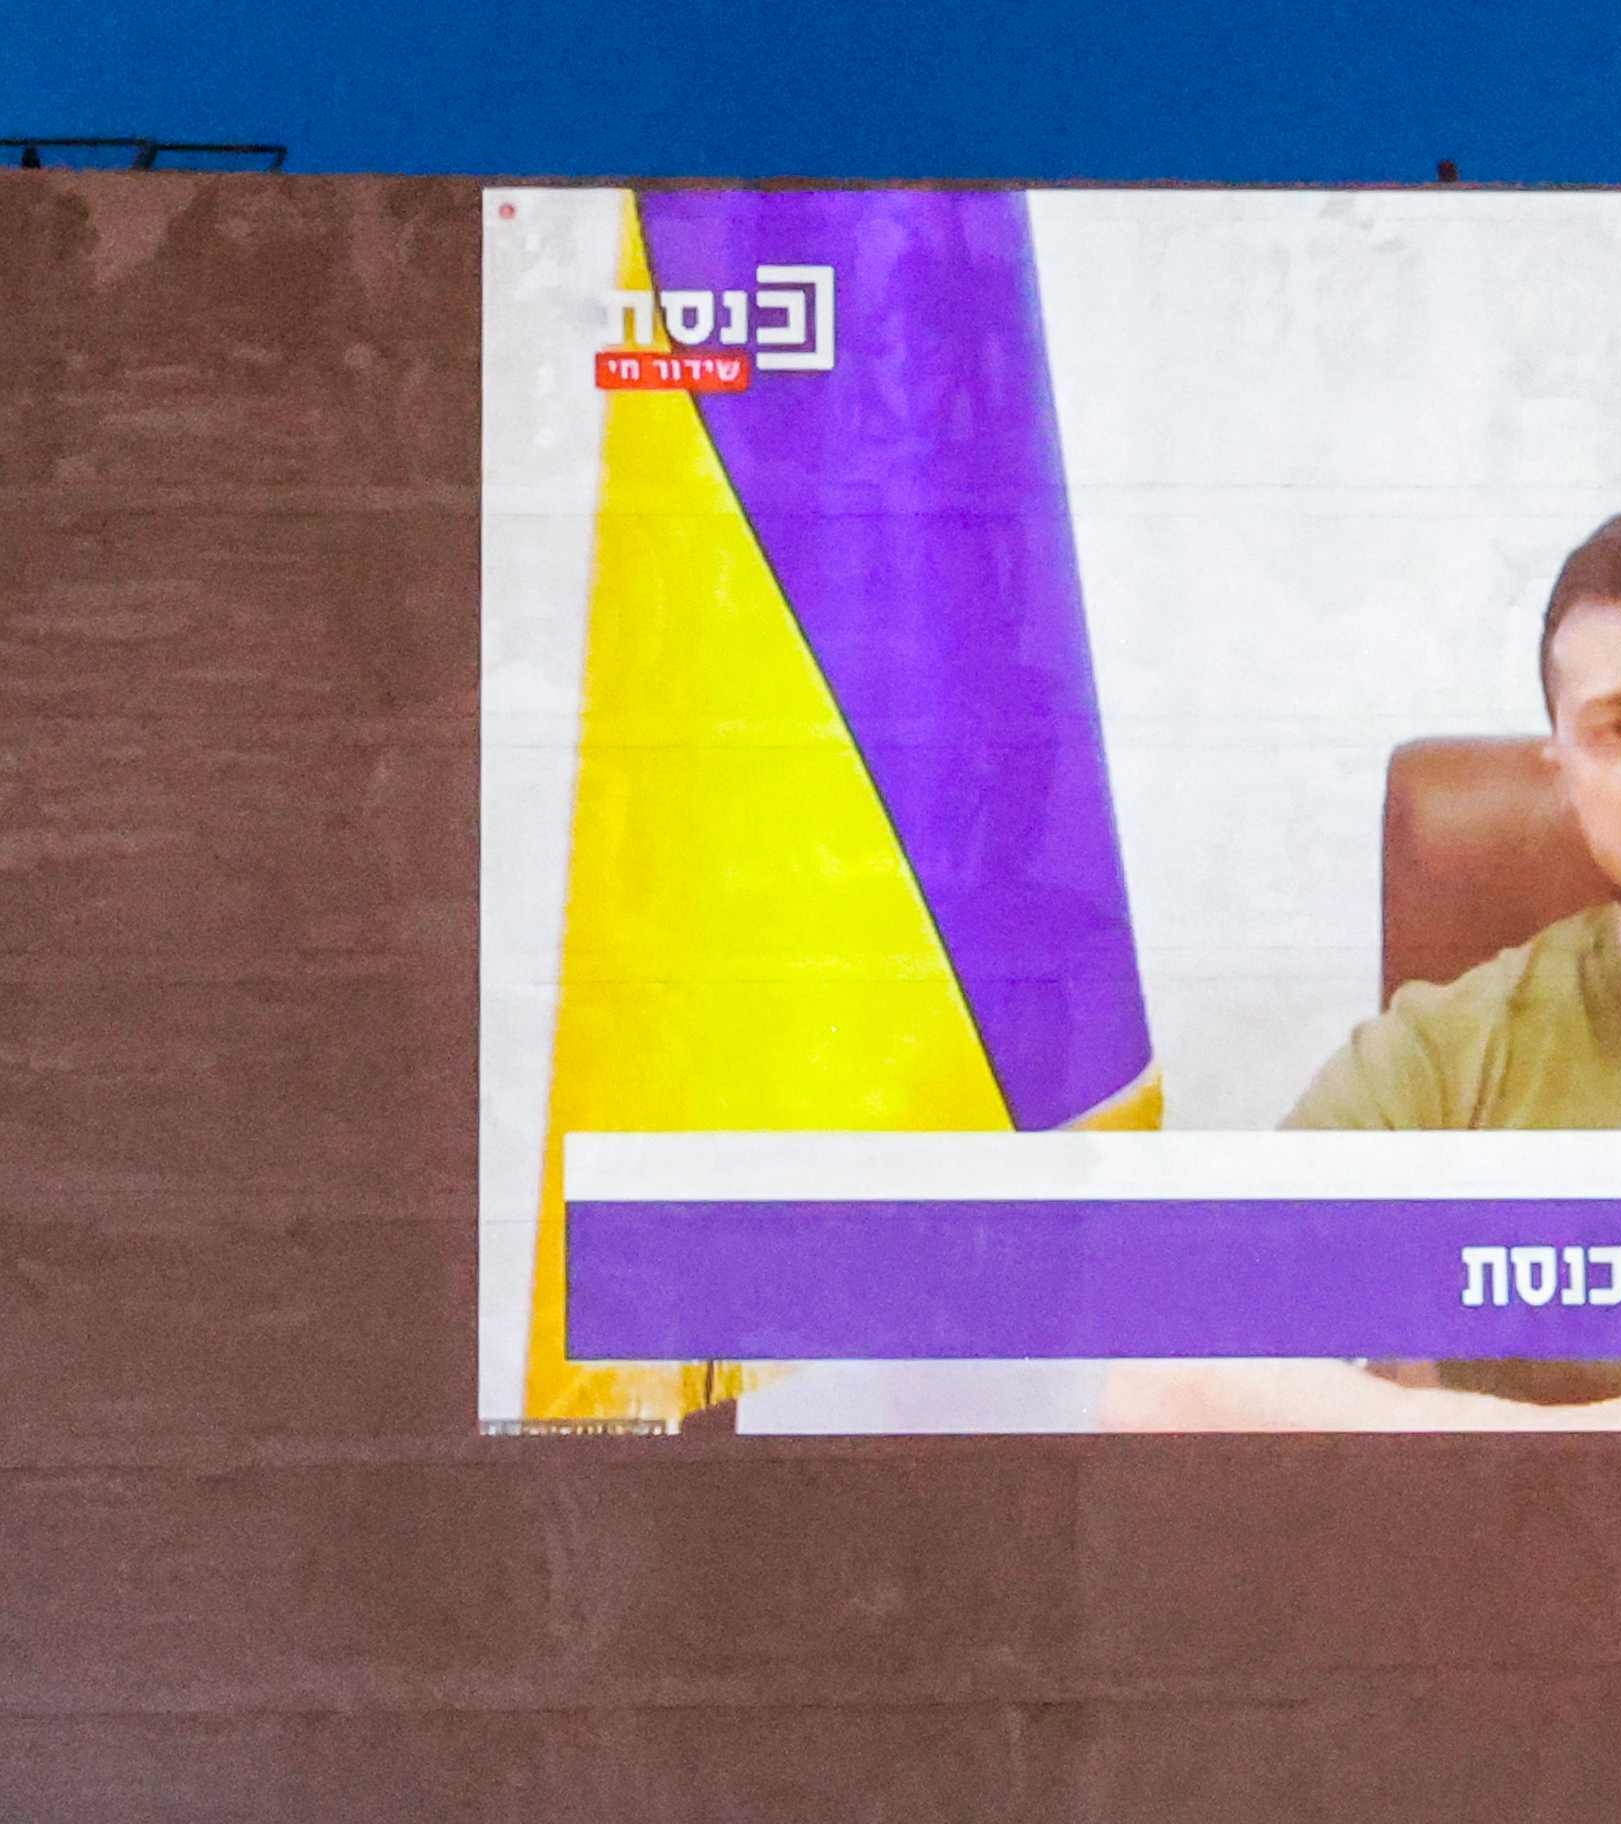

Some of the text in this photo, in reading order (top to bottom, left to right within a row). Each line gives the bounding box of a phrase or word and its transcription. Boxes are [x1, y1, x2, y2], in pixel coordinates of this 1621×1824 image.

[605, 265, 834, 370] כנסת
[607, 358, 741, 383] שידור חי
